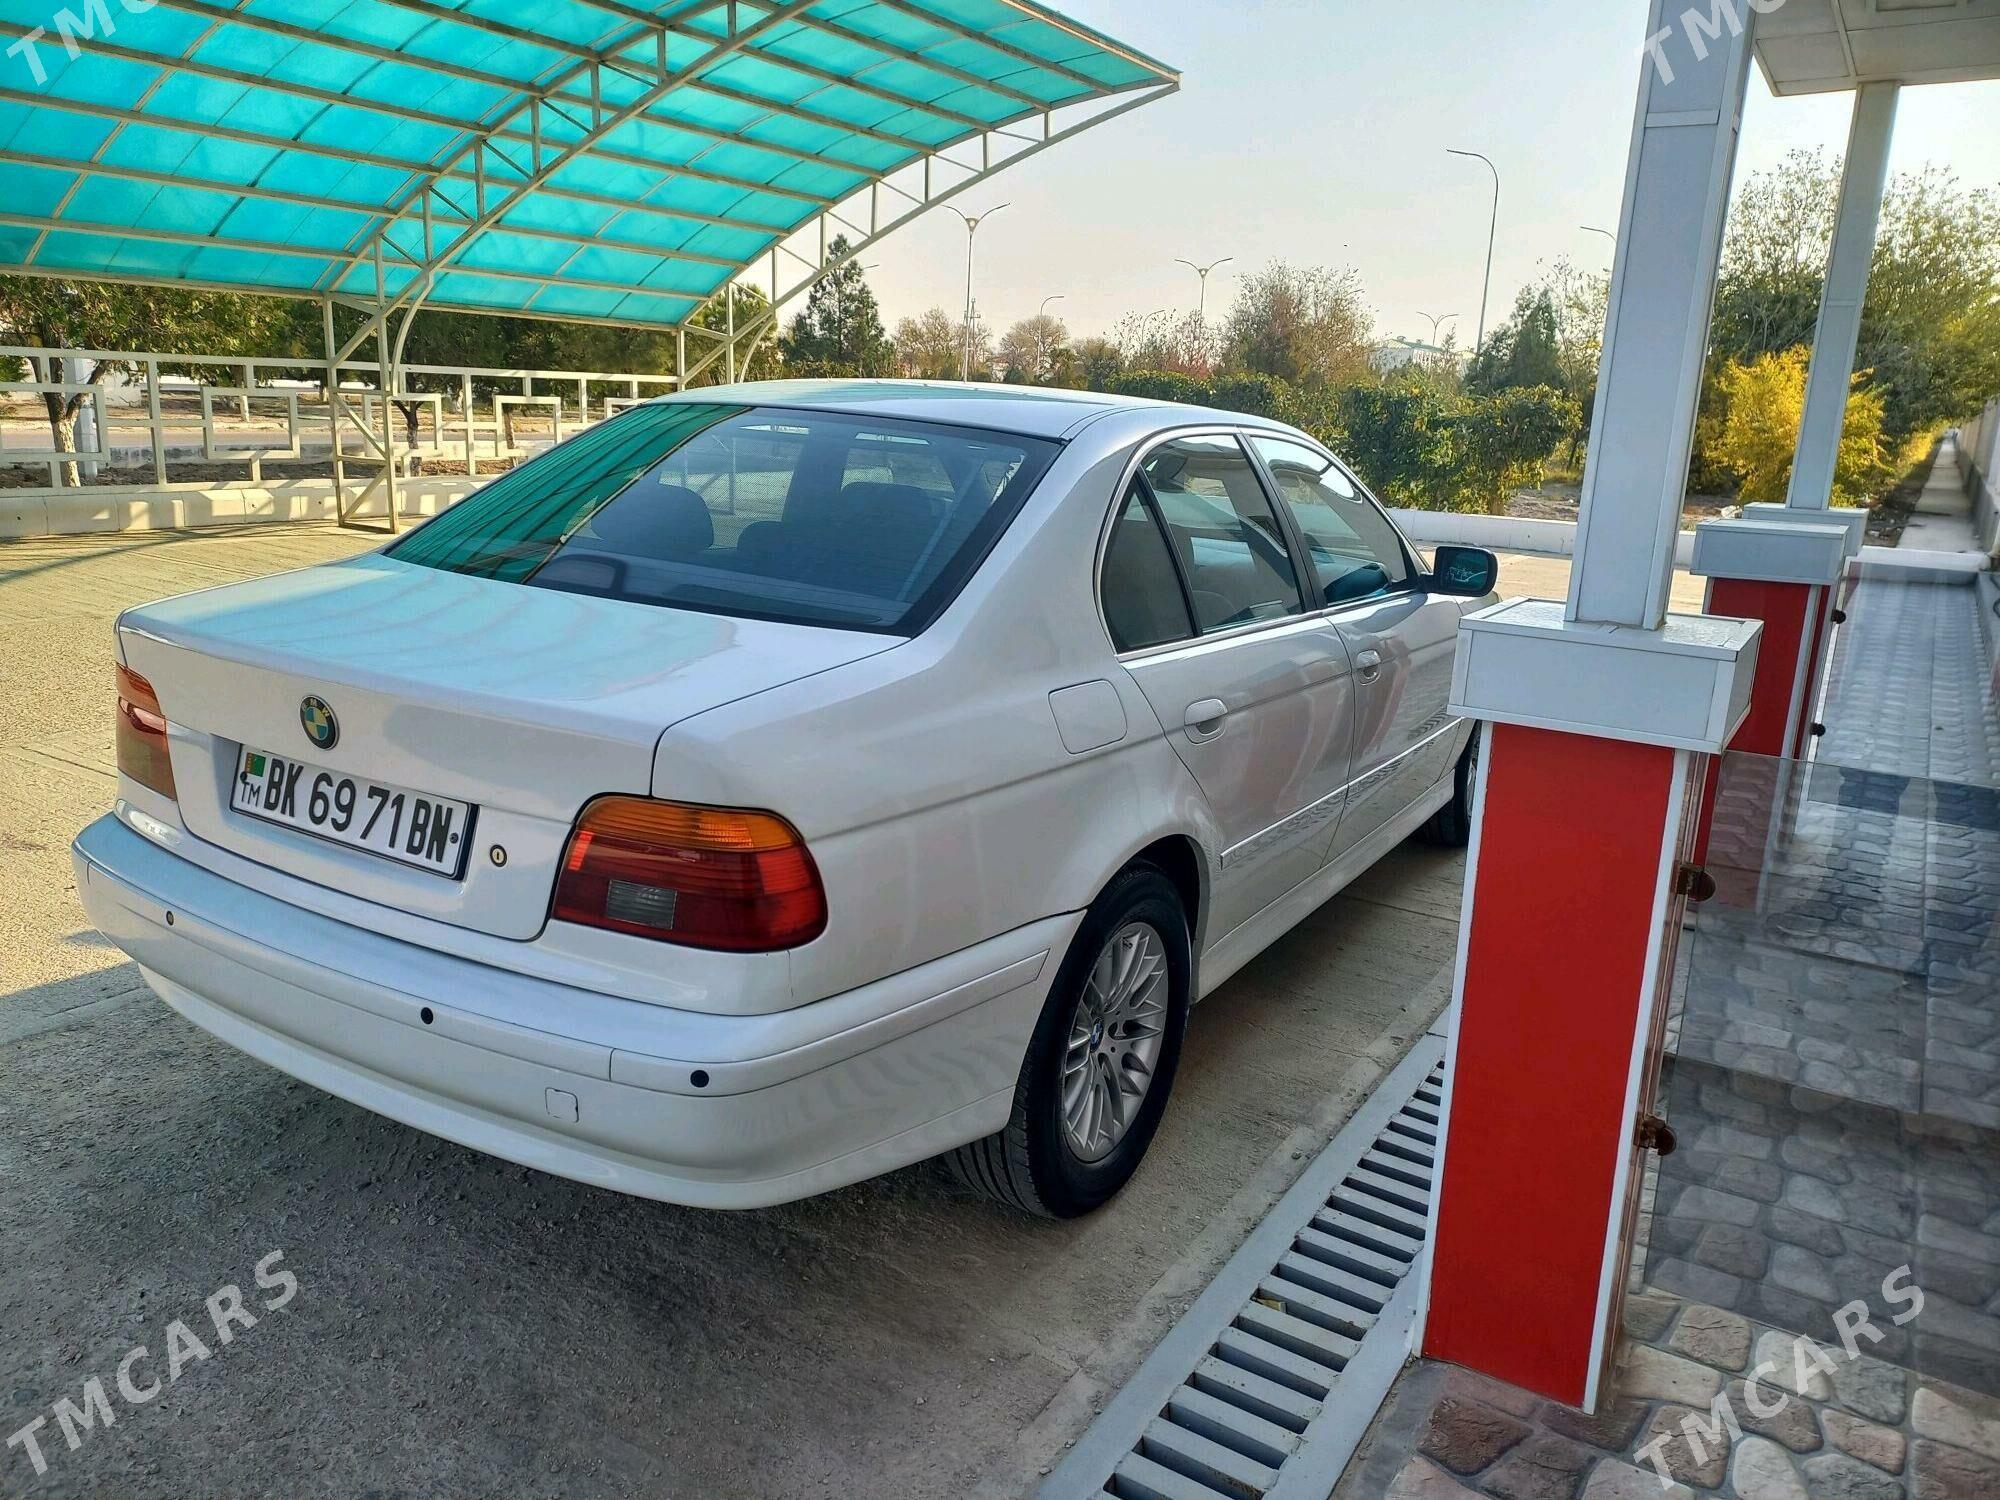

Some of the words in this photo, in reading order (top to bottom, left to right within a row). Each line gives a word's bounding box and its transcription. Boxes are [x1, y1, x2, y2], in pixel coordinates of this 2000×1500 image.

[240, 781, 261, 807] TM
[264, 758, 304, 817] BK
[308, 773, 356, 832] 69
[359, 785, 406, 848] 71
[406, 799, 453, 863] BN
